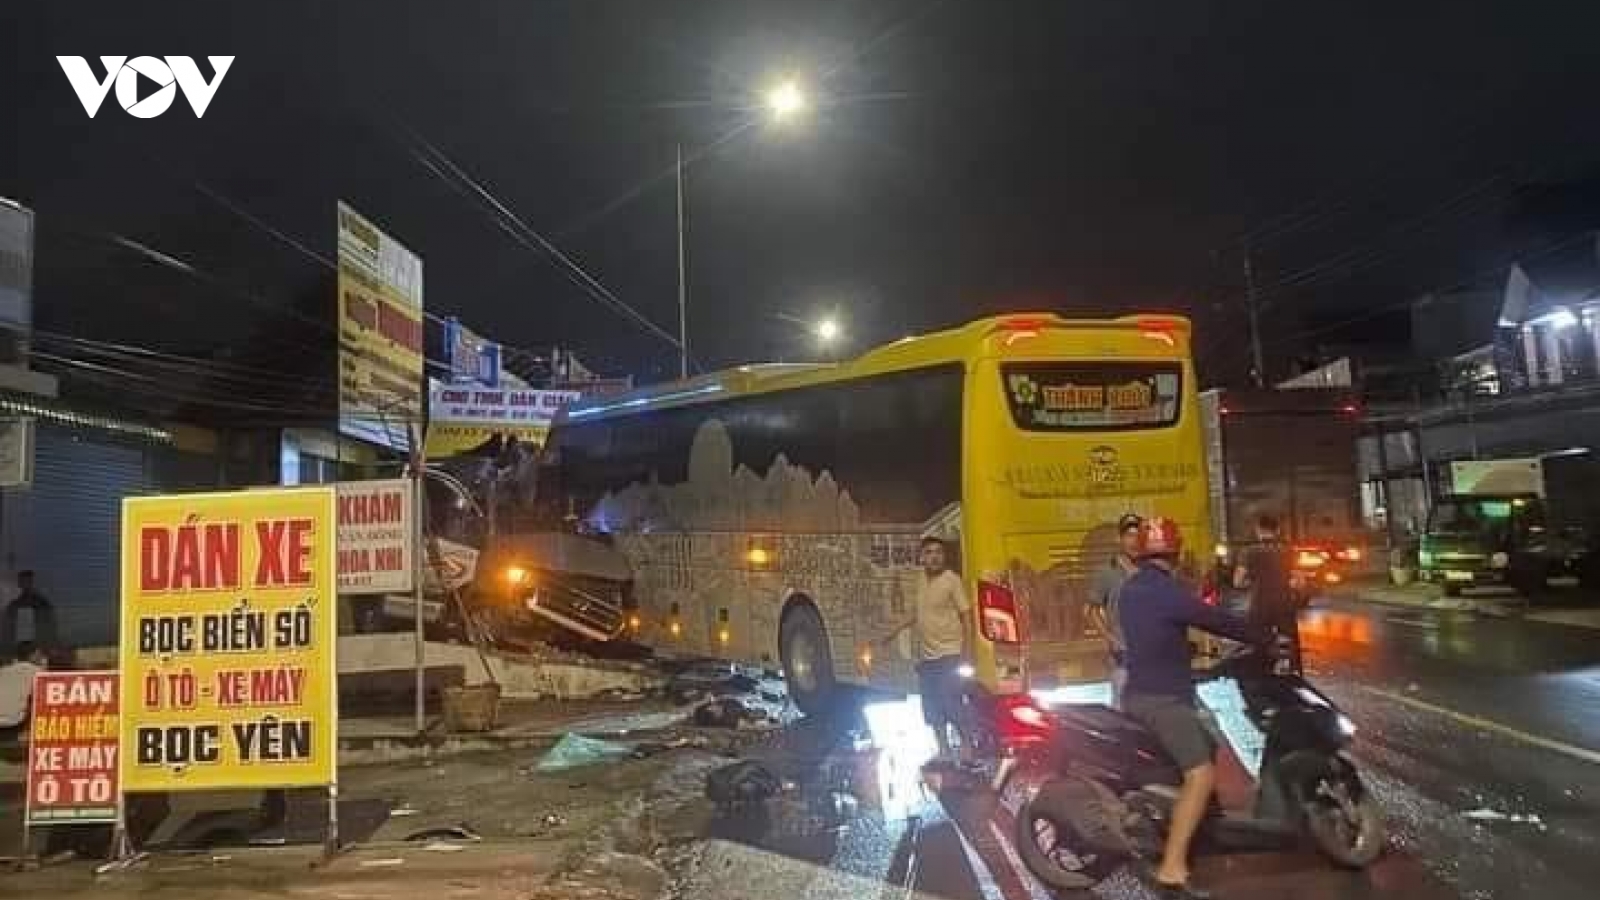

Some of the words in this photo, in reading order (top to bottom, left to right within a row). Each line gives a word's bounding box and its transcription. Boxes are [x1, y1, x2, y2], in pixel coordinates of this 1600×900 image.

[255, 520, 312, 585] XE
[139, 615, 195, 660] BỌC
[202, 598, 266, 651] BIỂN
[274, 597, 318, 648] SỐ
[46, 676, 112, 704] BÁN
[168, 667, 195, 707] TÔ
[217, 671, 248, 704] XE
[250, 664, 304, 702] MÁY
[35, 747, 63, 771] XE
[68, 742, 116, 770] MÁY
[137, 724, 220, 774] BỌC
[231, 714, 311, 761] YÊN
[37, 774, 60, 803] Ô
[70, 773, 110, 802] TÔ
